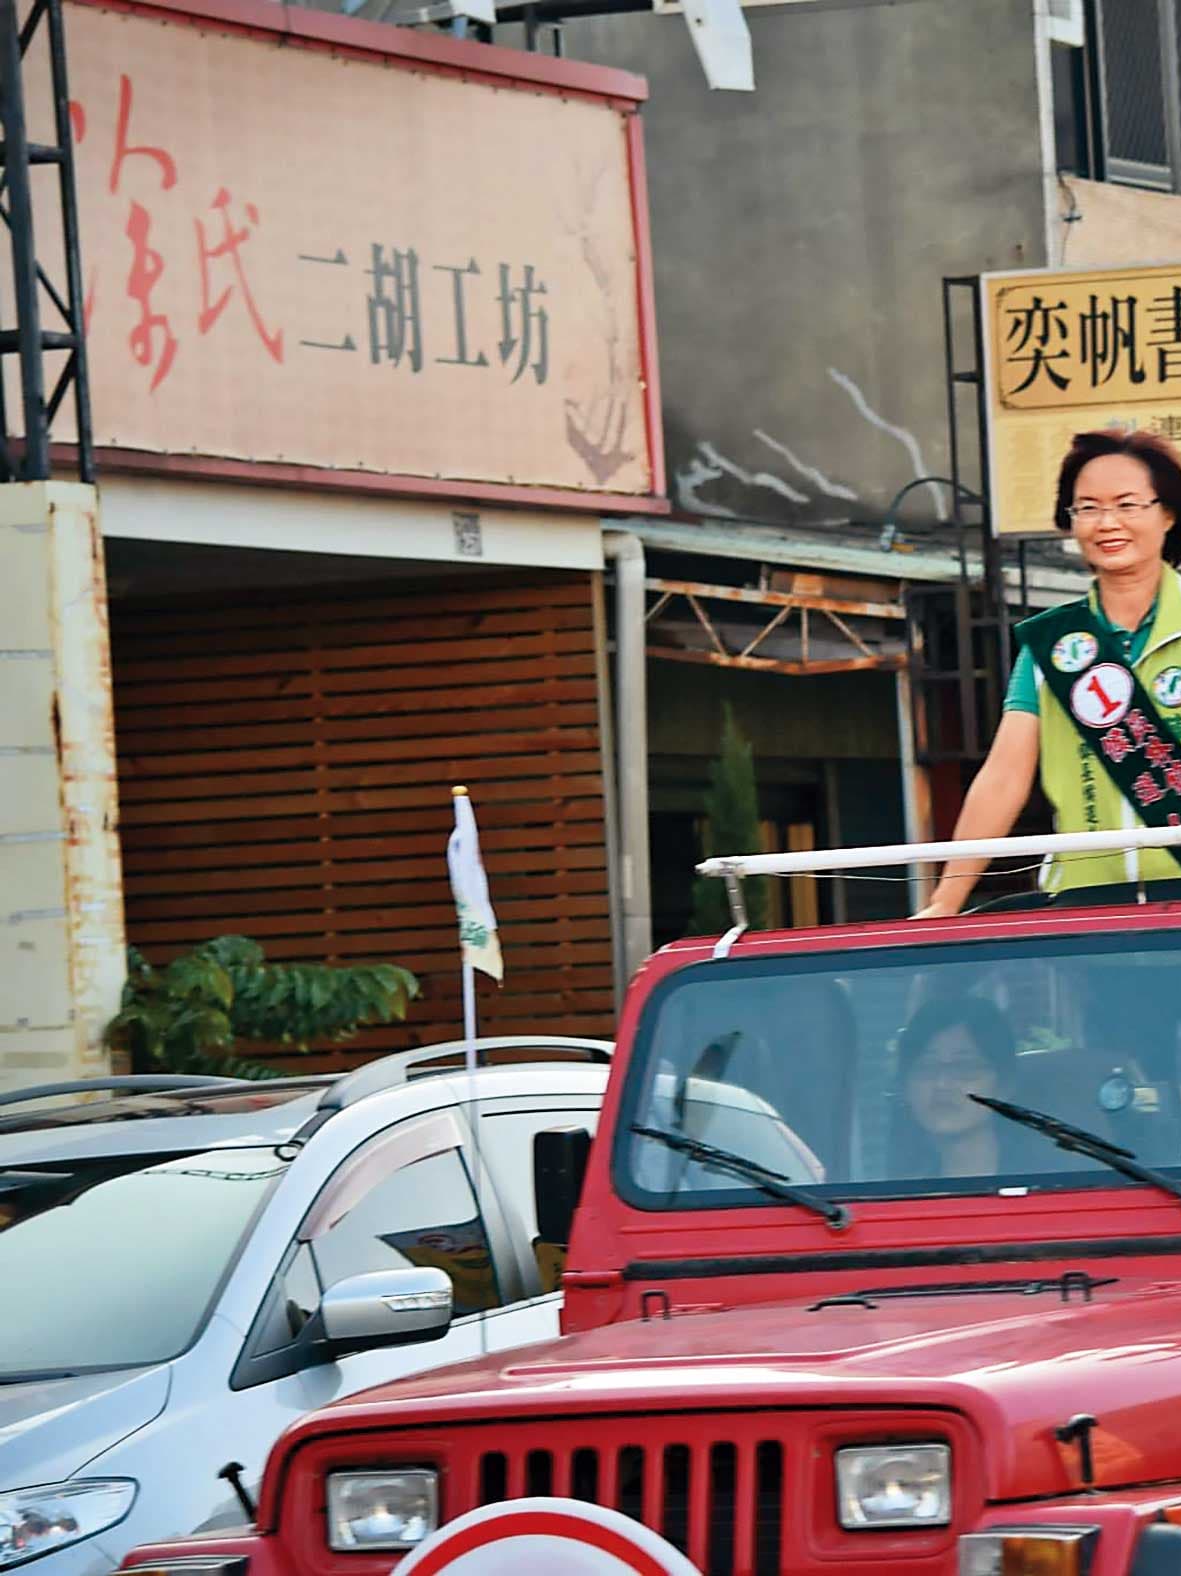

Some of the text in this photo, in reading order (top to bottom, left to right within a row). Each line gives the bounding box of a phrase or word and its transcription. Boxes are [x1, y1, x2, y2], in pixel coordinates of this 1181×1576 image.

[299, 242, 550, 386] 二胡工坊
[1087, 675, 1122, 719] 1
